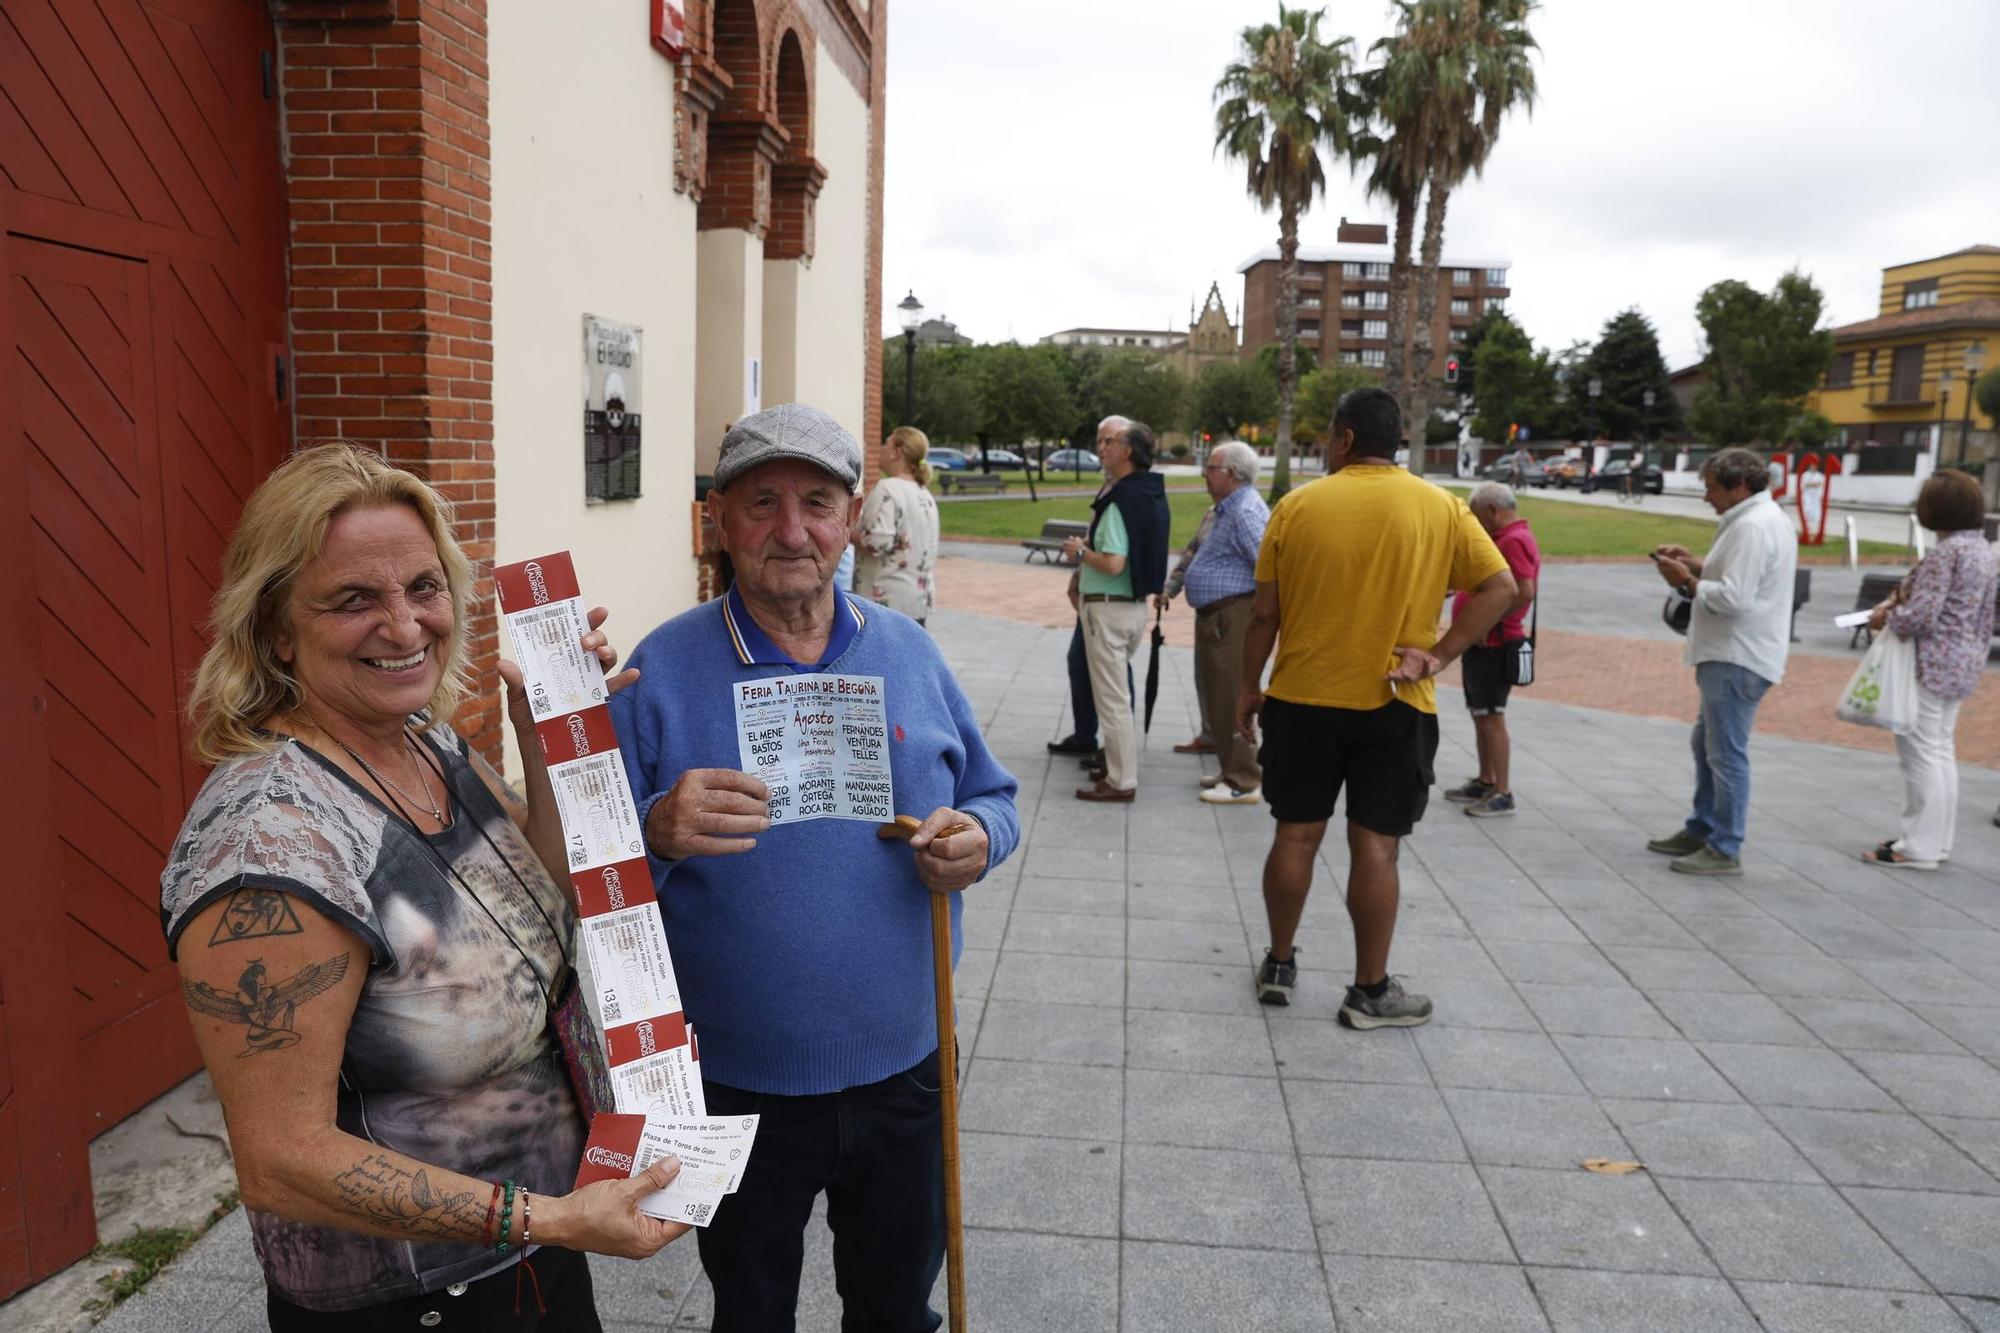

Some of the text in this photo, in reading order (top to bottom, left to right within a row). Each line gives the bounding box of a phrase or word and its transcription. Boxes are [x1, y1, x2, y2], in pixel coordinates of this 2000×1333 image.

[557, 616, 575, 667] CORRIDA DE TOROS
[568, 599, 578, 616] Plaza
[573, 617, 580, 626] de
[582, 655, 592, 673] Gijón
[531, 681, 544, 696] 16
[742, 678, 877, 700] FERIA TAURINA DE BEGOÑA
[793, 710, 834, 735] Agosto
[842, 724, 884, 737] FERNANDES
[569, 722, 584, 757] TAURINOS
[813, 737, 828, 745] Feria
[846, 737, 882, 748] VENTURA
[752, 741, 782, 754] BASTOS
[852, 749, 878, 760] TELLES
[607, 751, 617, 769] Plaza
[757, 754, 780, 766] OLGA
[612, 770, 620, 779] de
[615, 780, 624, 798] Toros
[798, 779, 835, 792] MORANTE
[845, 781, 891, 793] MANZANARES
[597, 769, 614, 820] CORRIDA DE TOROS
[801, 790, 834, 803] ORTEGA
[848, 792, 889, 805] TALAVANTE
[619, 799, 627, 808] de
[799, 802, 837, 815] ROCA REY
[620, 808, 631, 826] Gijón
[852, 806, 888, 817] AGUADO
[571, 833, 583, 848] 17
[603, 877, 618, 910] TAURINOS
[644, 904, 654, 922] Plaza
[648, 922, 656, 931] de
[632, 921, 649, 972] NOVILLADA PICADA
[650, 932, 660, 951] Toros
[655, 952, 663, 961] de
[656, 962, 667, 979] Gijón
[603, 987, 616, 1002] 13
[675, 1048, 684, 1063] Plaza
[678, 1063, 685, 1071] de
[661, 1064, 671, 1086] CORRIDA
[680, 1072, 689, 1090] Toros
[684, 1091, 691, 1099] de
[710, 1123, 725, 1132] Gijón
[643, 1131, 661, 1142] Plaza
[662, 1136, 672, 1144] de
[673, 1140, 692, 1149] Toros
[701, 1146, 715, 1156] Gijón
[587, 1145, 633, 1164] CIRCUITOS
[593, 1155, 631, 1172] TAURINOS
[683, 1203, 695, 1216] 13
